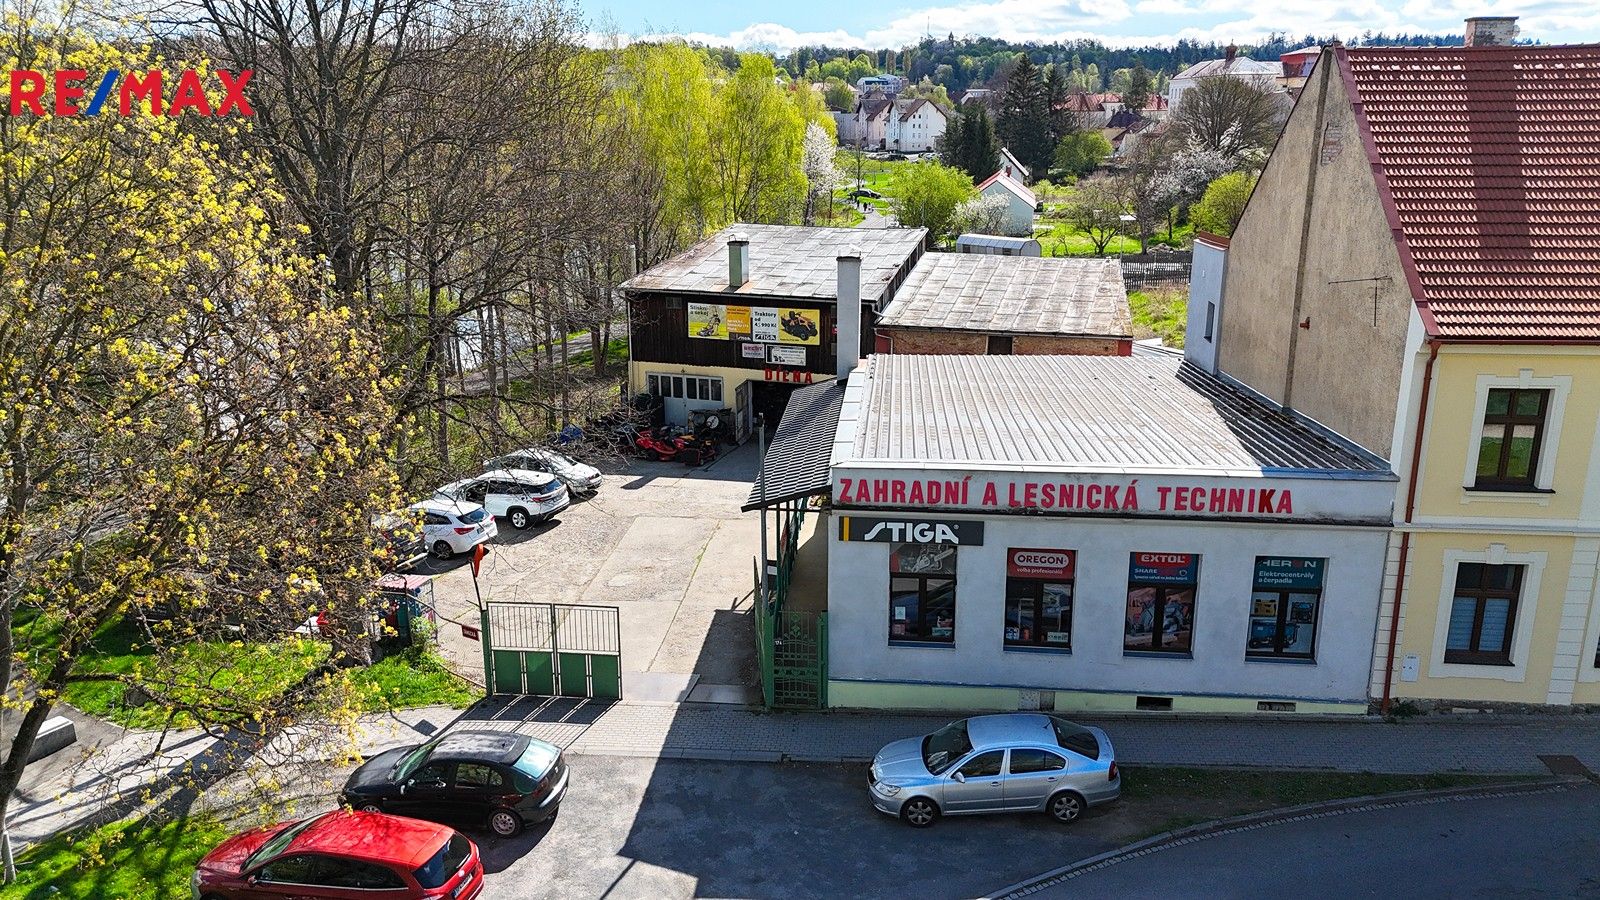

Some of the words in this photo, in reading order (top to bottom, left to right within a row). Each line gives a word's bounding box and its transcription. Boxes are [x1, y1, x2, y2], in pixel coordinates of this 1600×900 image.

[839, 475, 972, 505] ZAHRADNÍ
[982, 482, 998, 506] A
[1008, 479, 1139, 510] LESNICKÁ
[1157, 486, 1293, 514] TECHNIKA
[864, 521, 960, 544] STIGA
[1017, 554, 1064, 565] OREGON
[1140, 554, 1186, 563] EXTOL
[1259, 571, 1315, 580] Elektrocentrály
[1263, 577, 1293, 585] čerpadla
